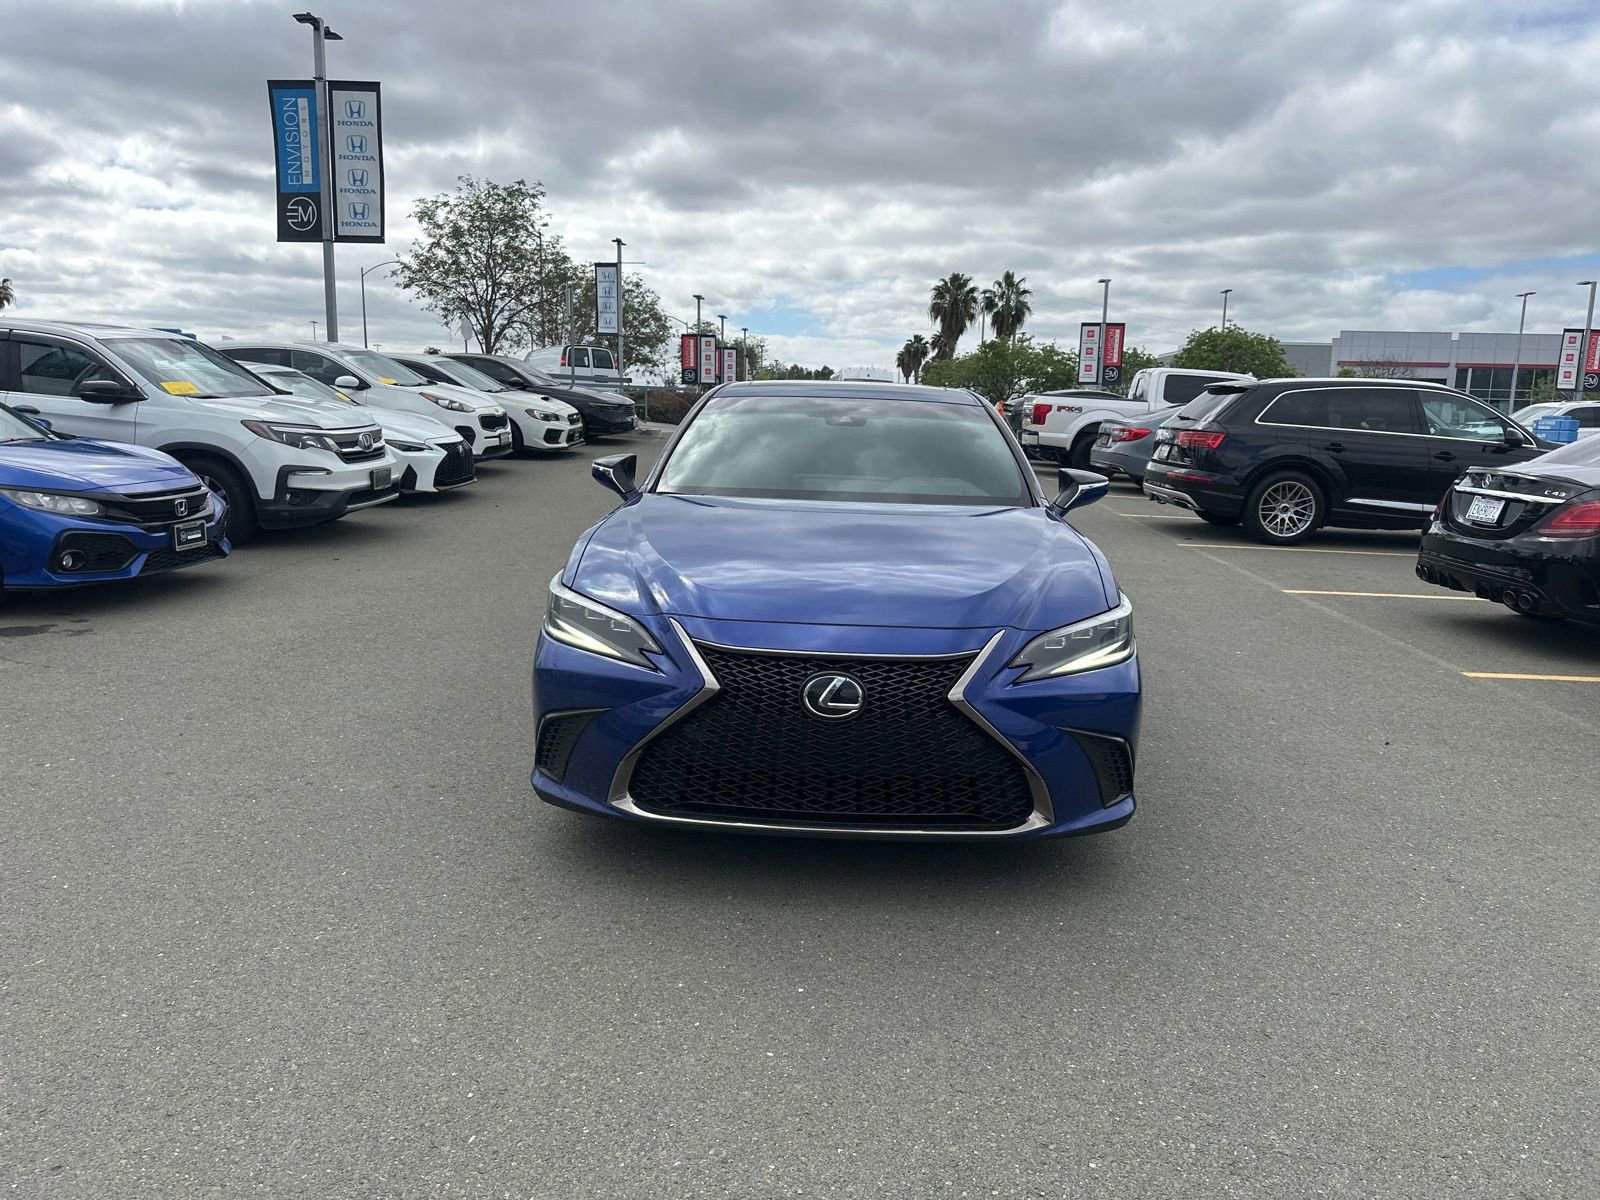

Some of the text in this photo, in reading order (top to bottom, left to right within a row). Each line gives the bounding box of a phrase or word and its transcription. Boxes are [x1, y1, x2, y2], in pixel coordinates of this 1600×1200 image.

[282, 97, 302, 185] ENVISION
[300, 105, 311, 177] MOTORS
[1106, 329, 1115, 363] ENVISION
[1586, 335, 1598, 370] ENVISION
